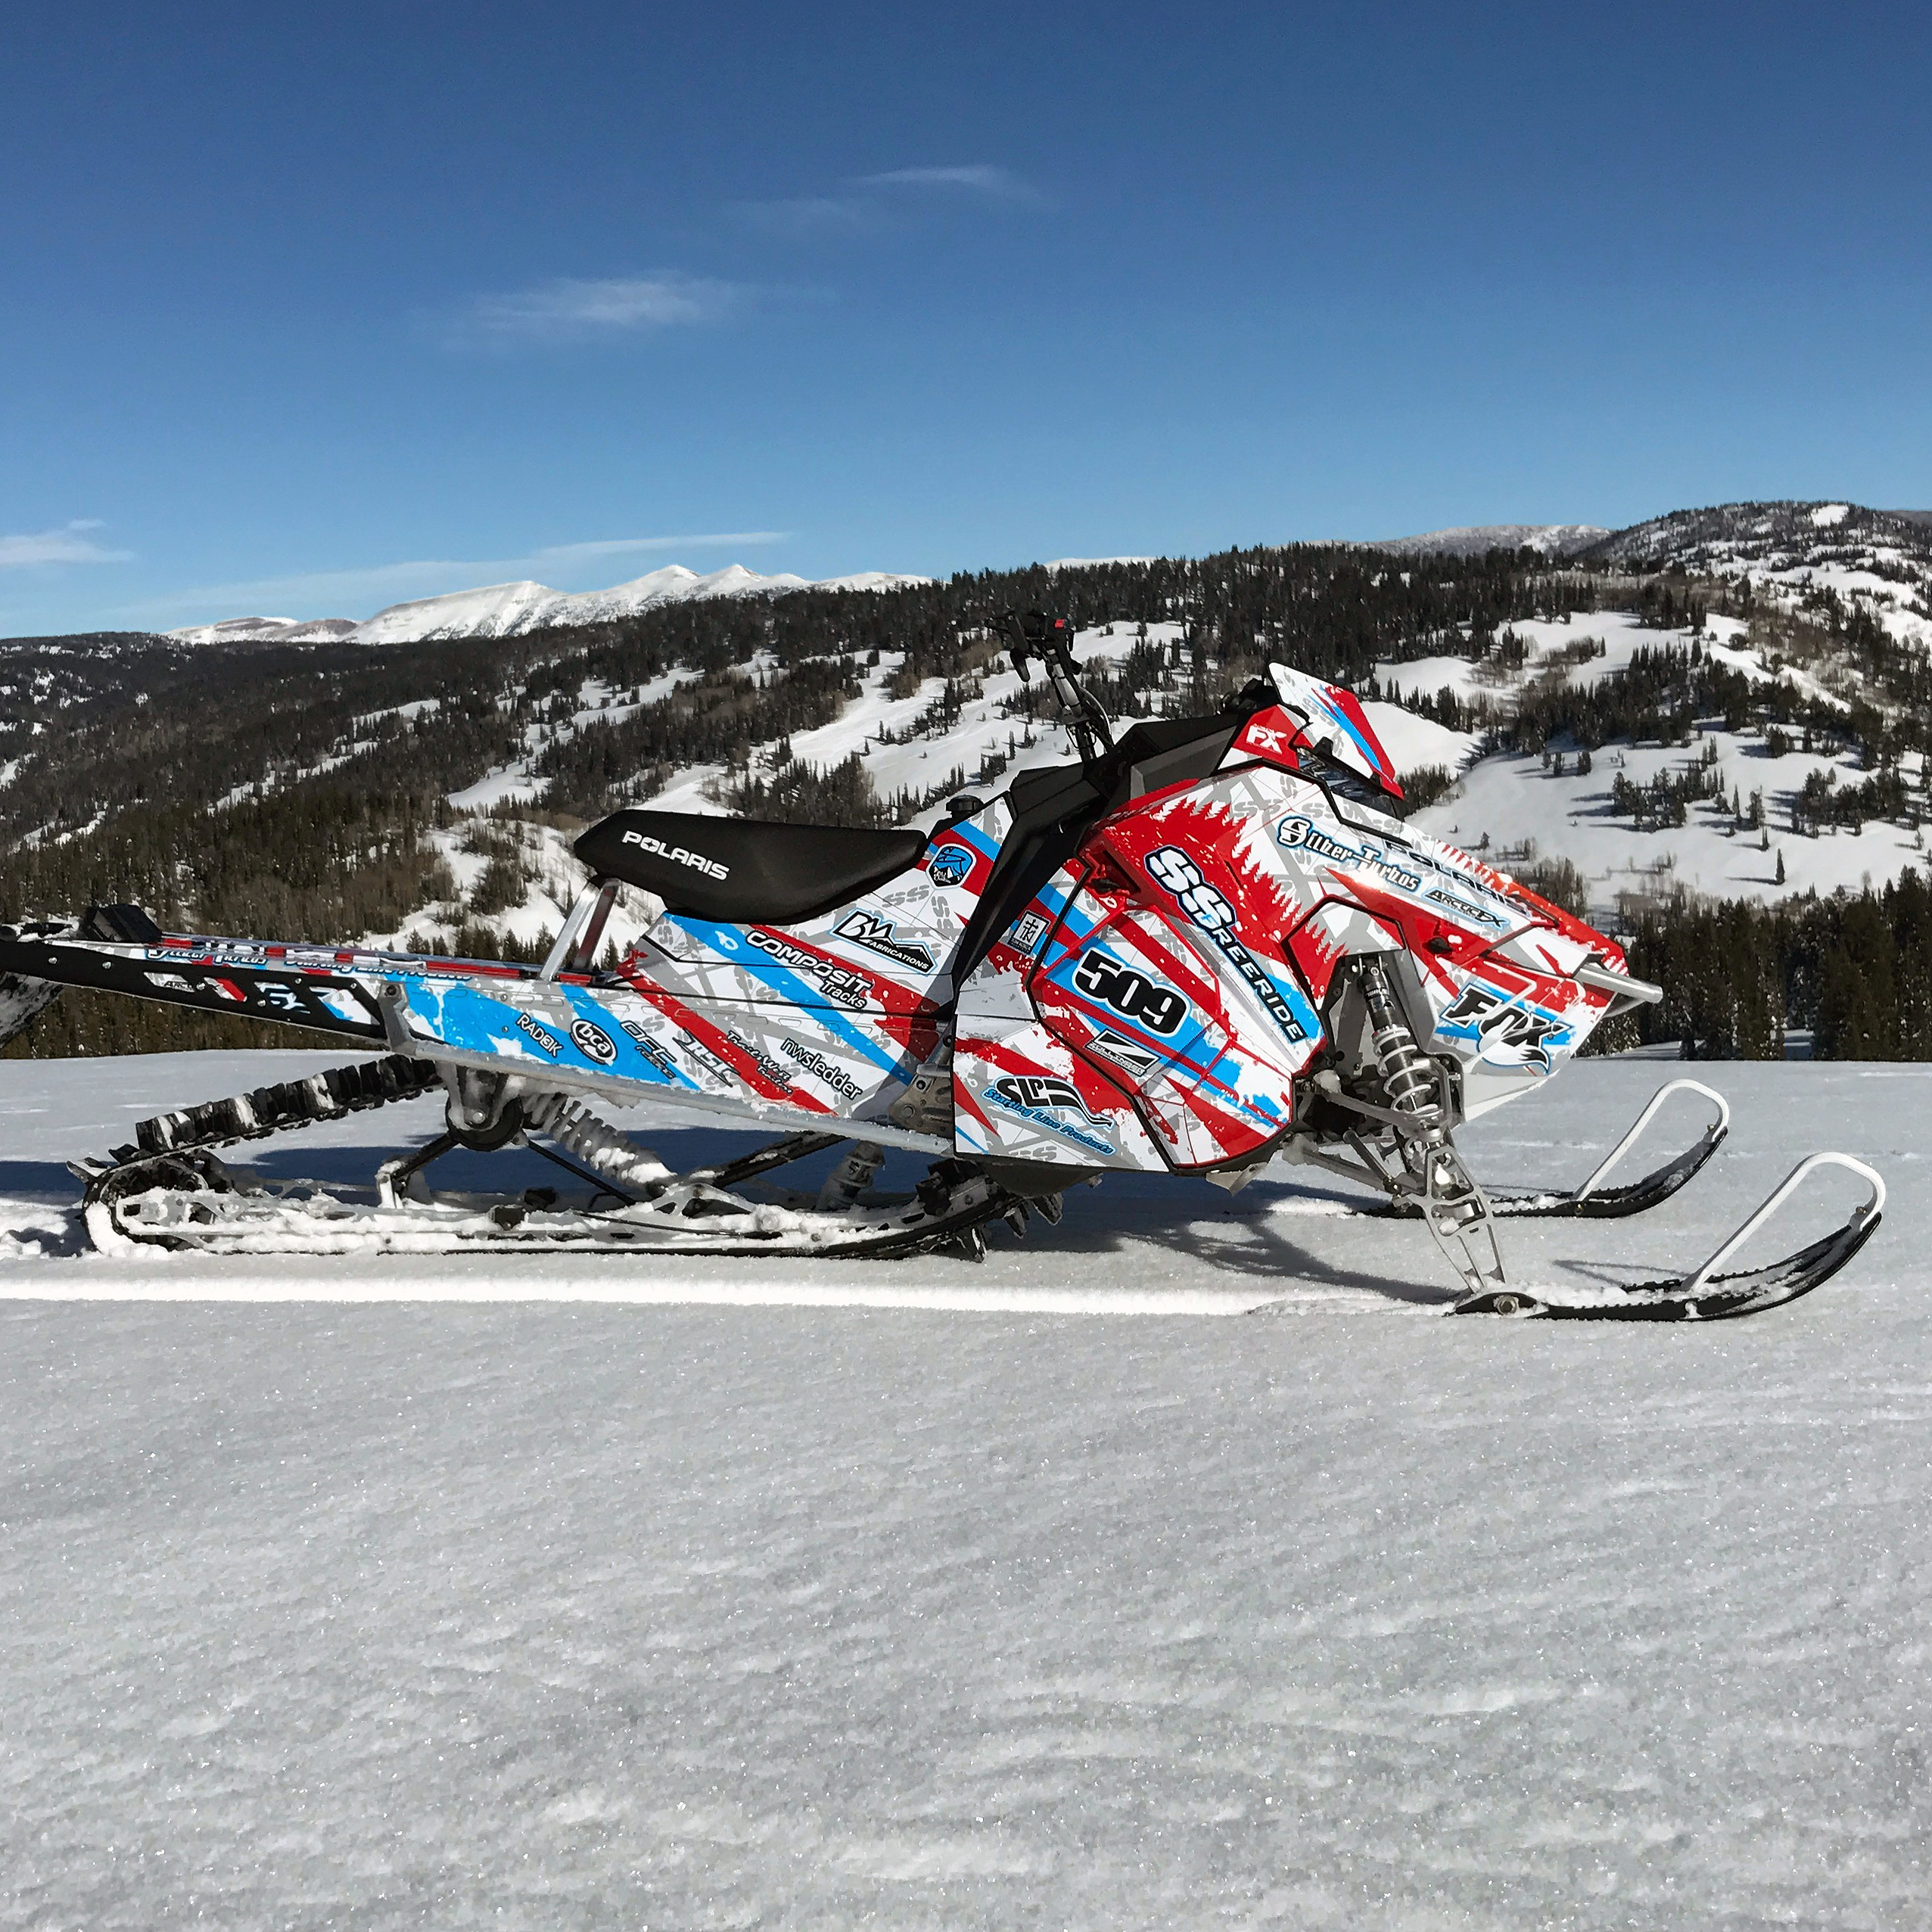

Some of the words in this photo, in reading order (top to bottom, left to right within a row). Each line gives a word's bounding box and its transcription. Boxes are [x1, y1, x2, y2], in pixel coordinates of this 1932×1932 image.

[1246, 724, 1286, 754] FX
[622, 831, 730, 880] POLARIS
[1385, 841, 1529, 916] POLARIS
[747, 931, 873, 993] COMPOSIT
[1075, 949, 1187, 1034] 509
[821, 979, 867, 1009] Tracks
[1442, 986, 1570, 1048] FOX
[578, 1023, 611, 1054] bca
[782, 1038, 862, 1099] nwsledder
[983, 1088, 1034, 1118] Starting
[1032, 1109, 1061, 1129] Line
[1059, 1125, 1115, 1154] Products
